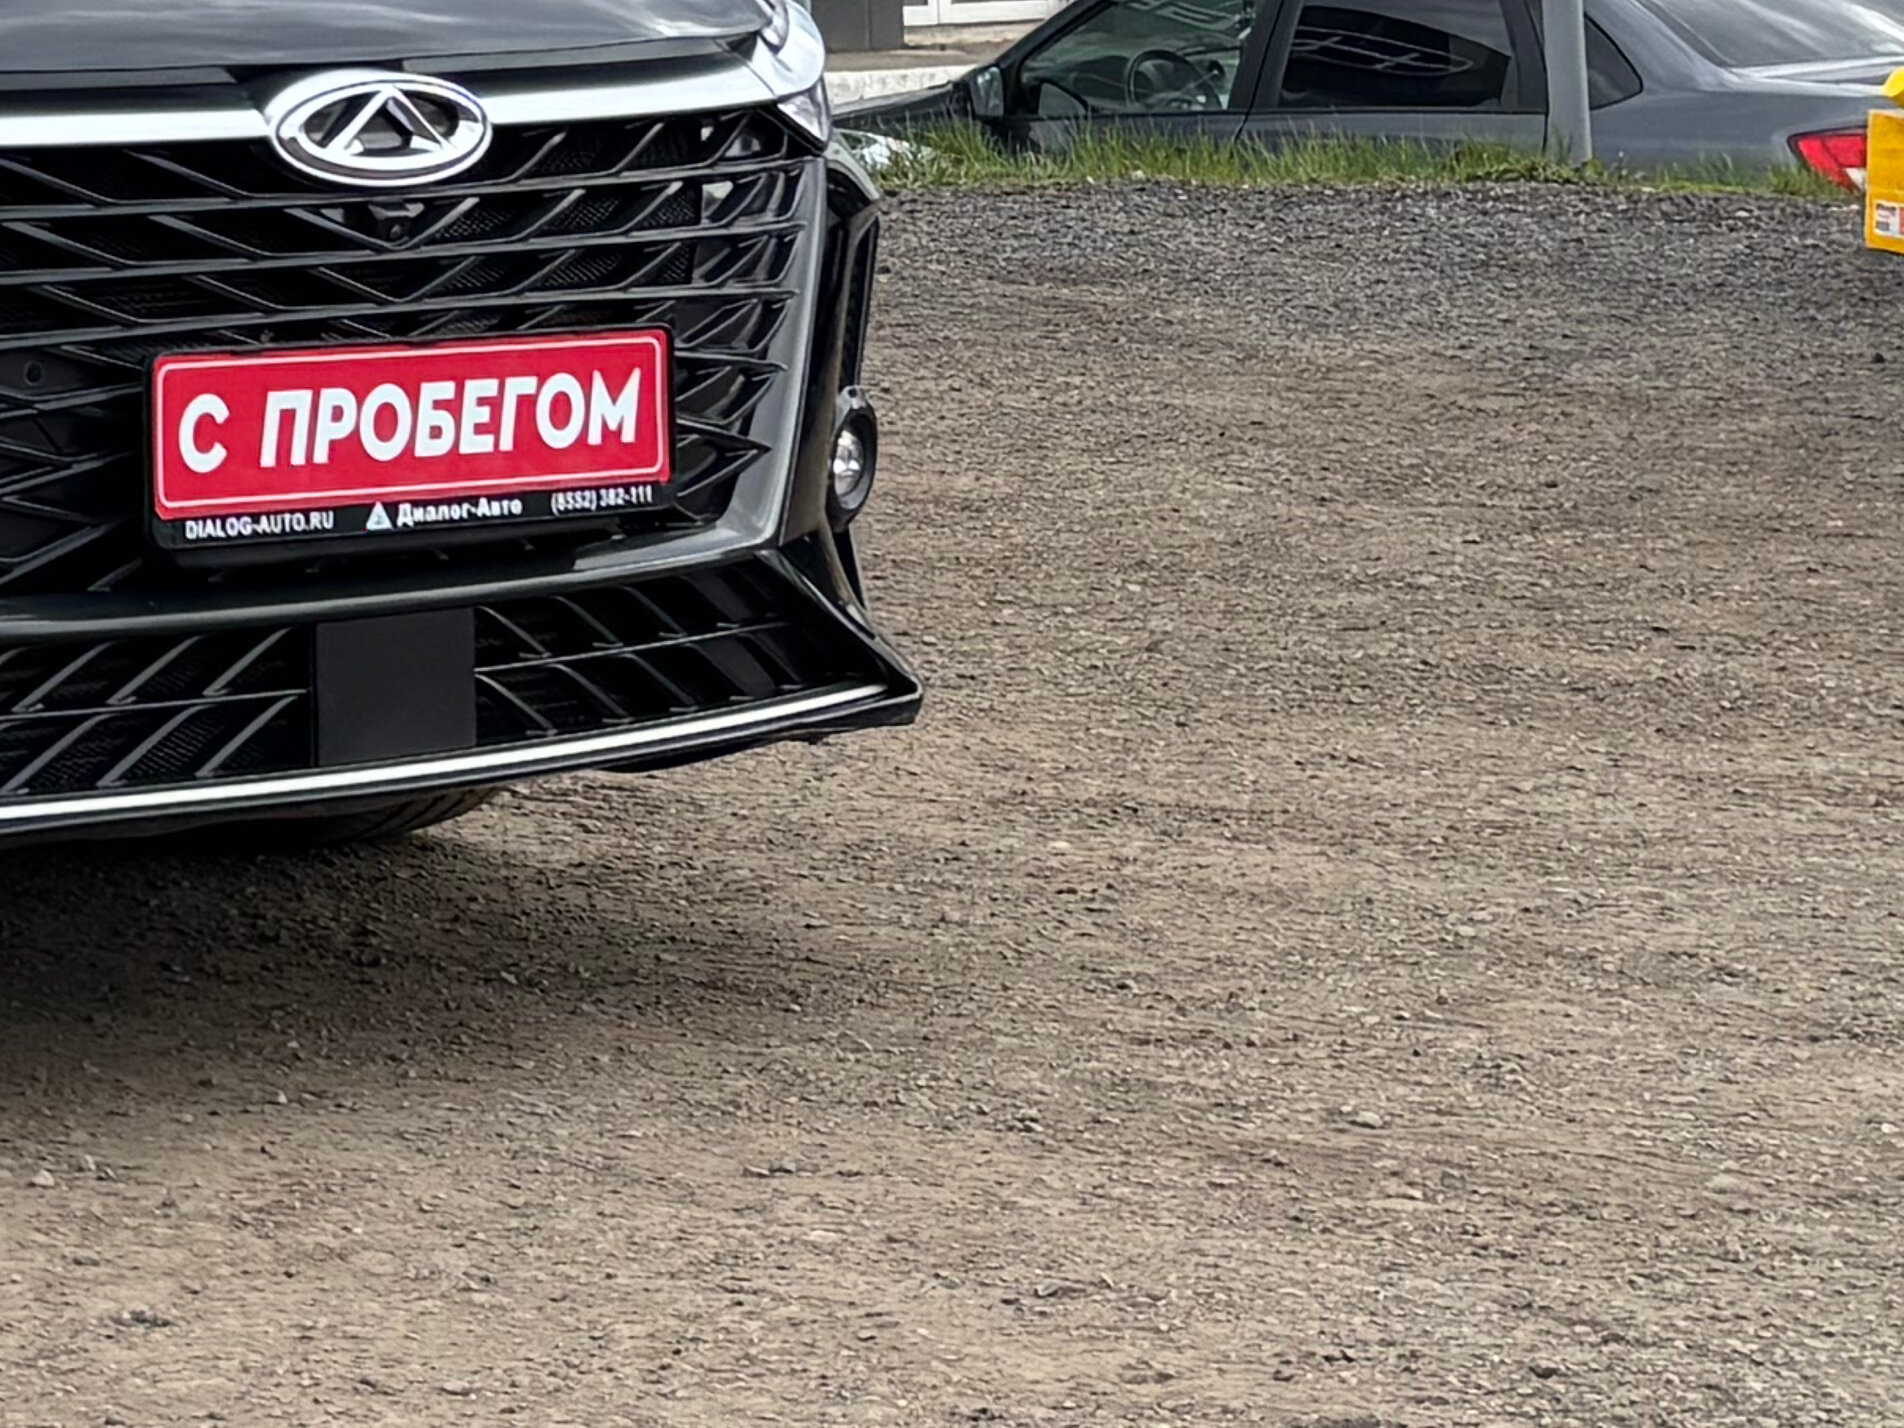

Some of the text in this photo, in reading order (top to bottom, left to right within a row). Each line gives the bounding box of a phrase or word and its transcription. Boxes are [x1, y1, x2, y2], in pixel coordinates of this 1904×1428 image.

[178, 366, 642, 474] С ПРОБЕГОМ
[185, 510, 334, 540] DIALOG-AUTO.RU
[396, 497, 523, 527] Диалог-Авто
